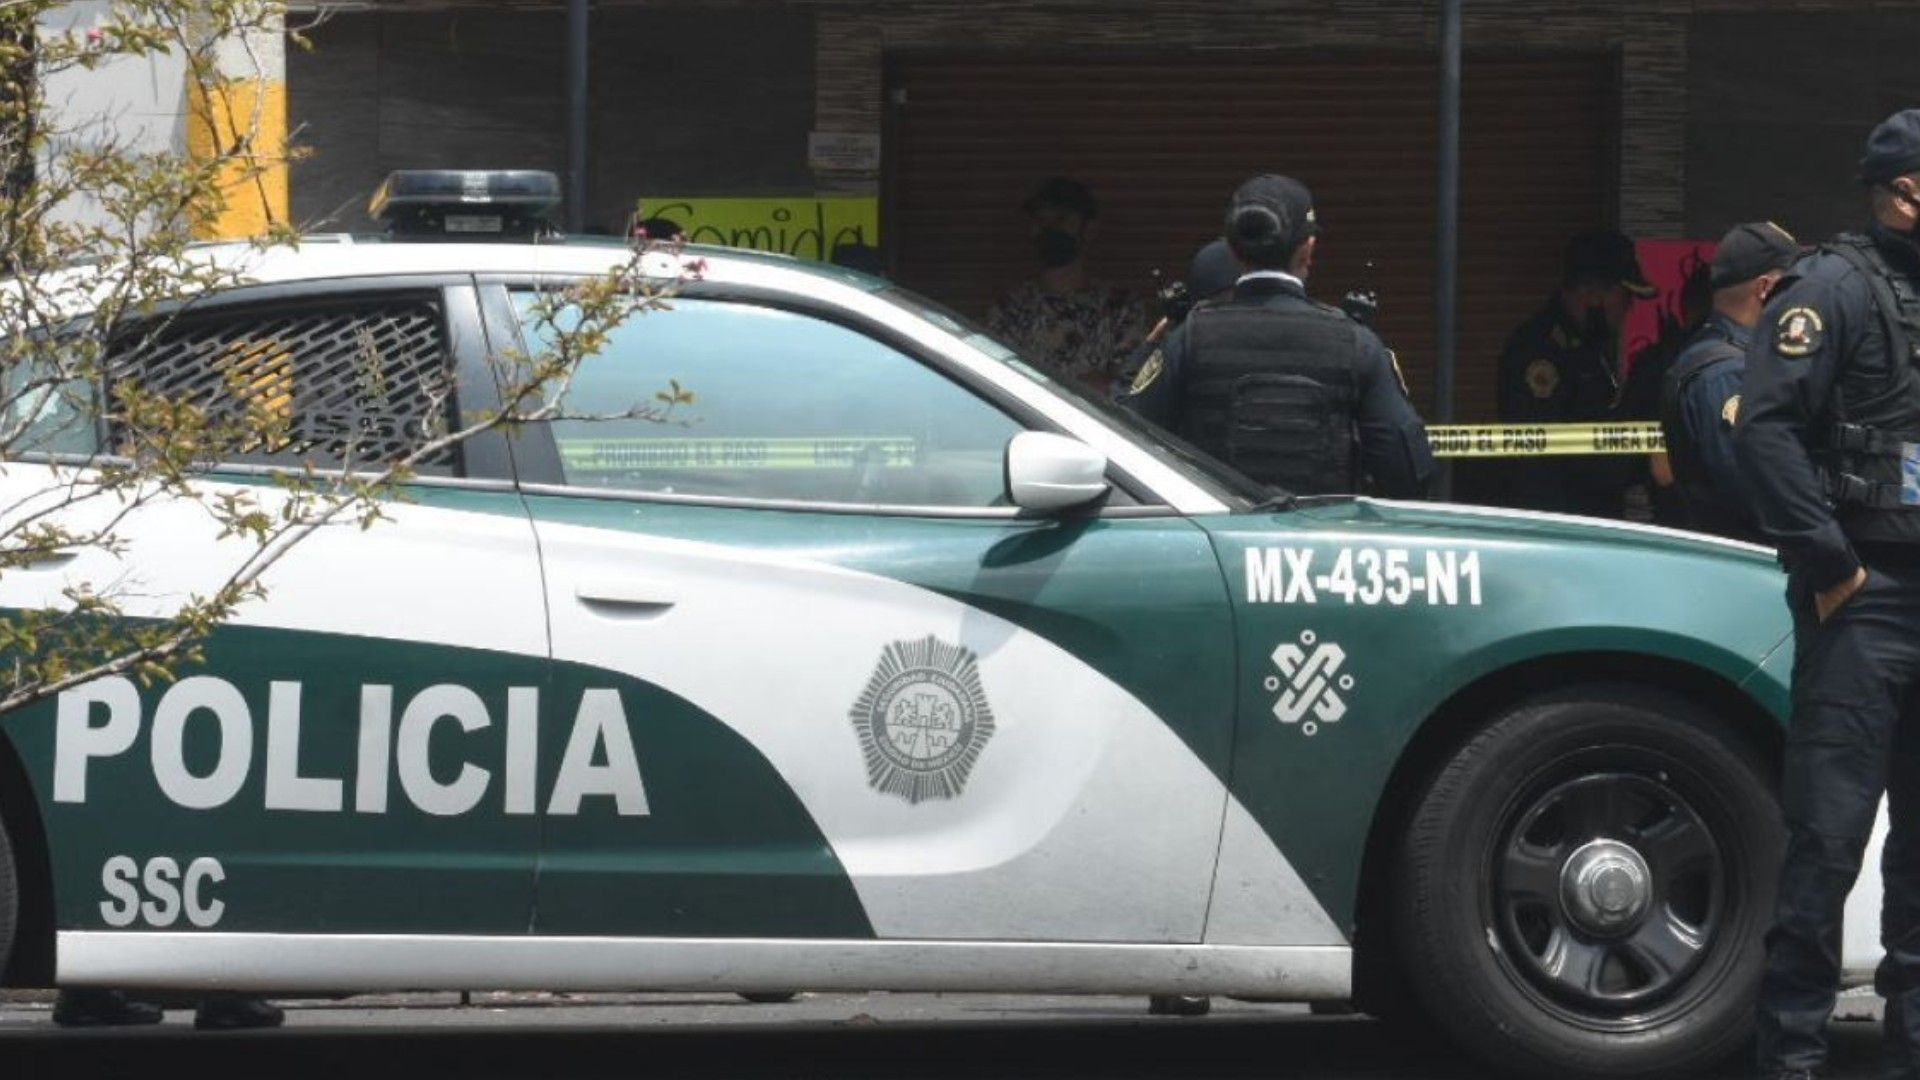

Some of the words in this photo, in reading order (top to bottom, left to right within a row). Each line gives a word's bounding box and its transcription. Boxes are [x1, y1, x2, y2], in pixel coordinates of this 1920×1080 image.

[1477, 429, 1495, 452] EL
[1503, 428, 1548, 452] PASO
[1593, 426, 1641, 450] LINEA
[1245, 547, 1483, 605] MX-435-N1
[53, 674, 651, 816] POLICIA
[100, 855, 226, 927] SSC
